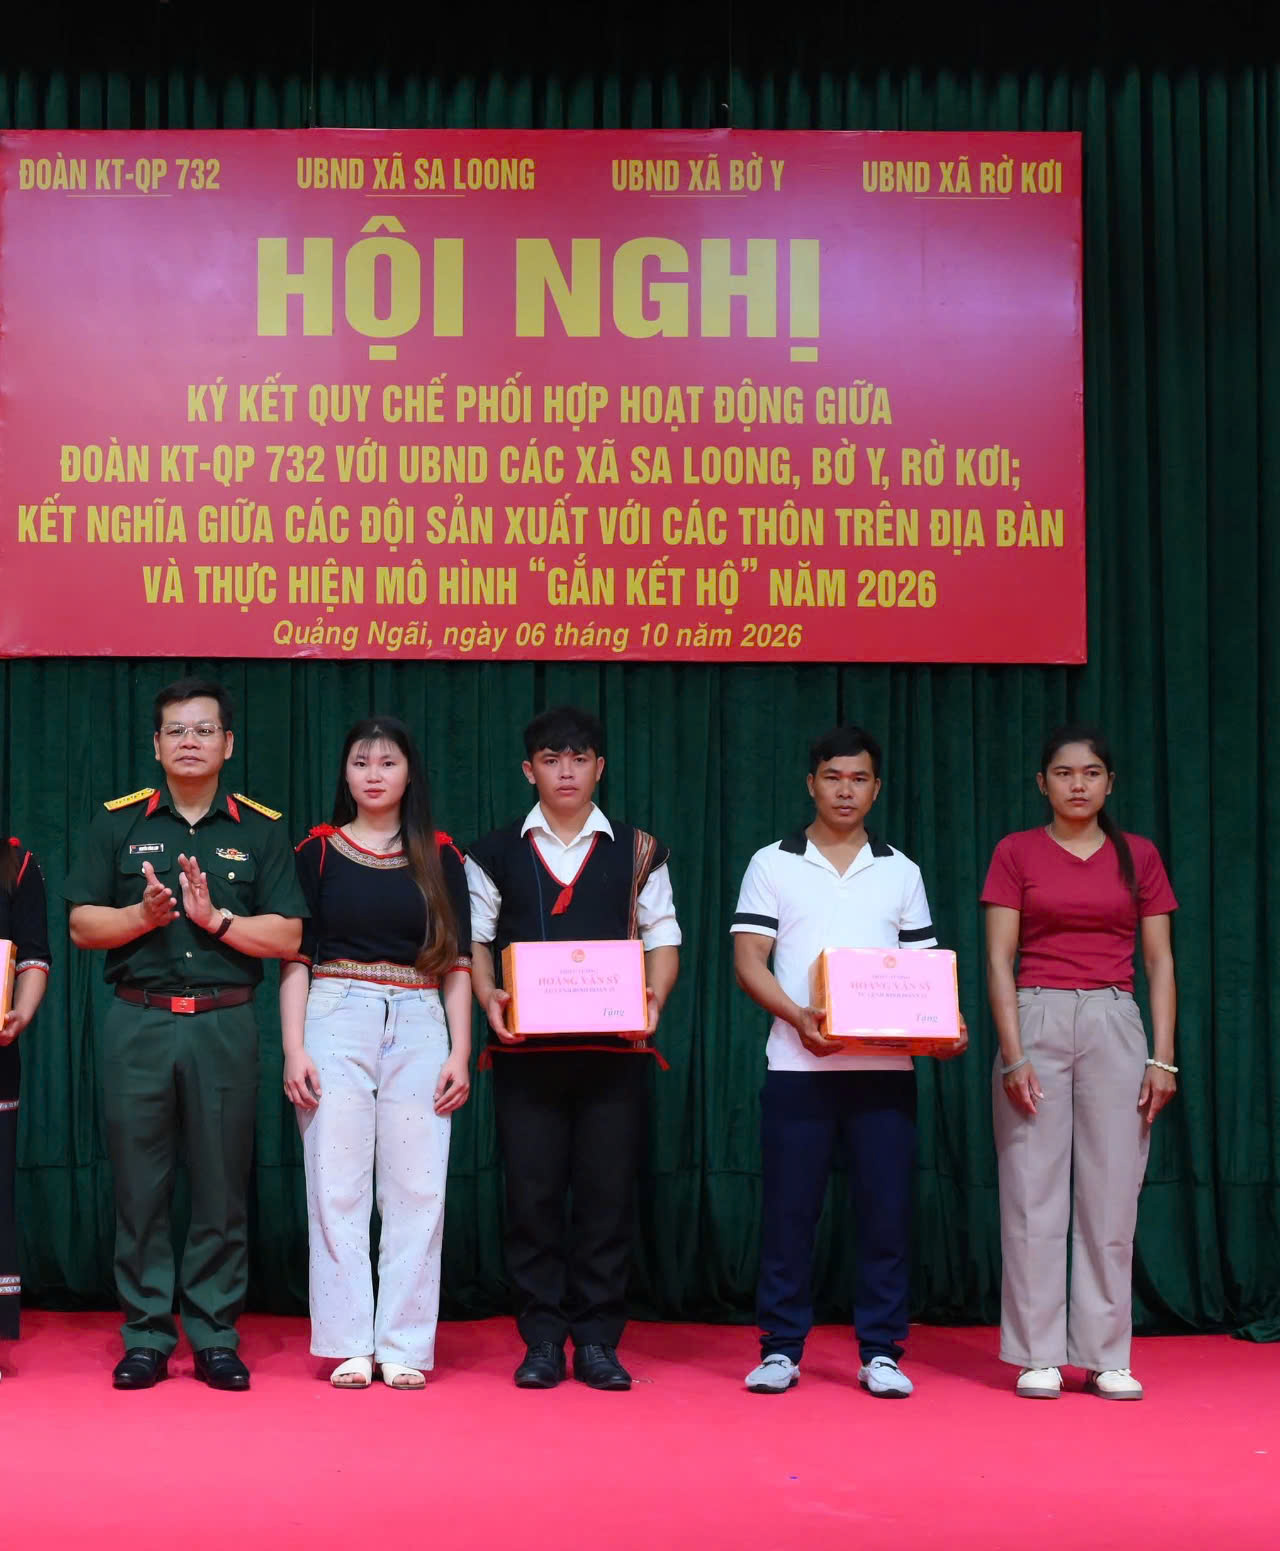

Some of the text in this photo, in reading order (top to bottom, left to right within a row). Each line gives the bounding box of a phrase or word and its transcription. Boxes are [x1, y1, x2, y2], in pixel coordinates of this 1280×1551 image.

[19, 152, 221, 193] ĐOÀN KT-QP 732
[296, 152, 535, 190] UBND XÃ SA LOONG
[612, 152, 785, 192] UBND XÃ BỜ Y
[863, 154, 1062, 194] UBND XÃ RỜ KƠI
[256, 215, 820, 363] HỘI NGHỊ
[187, 371, 893, 433] KÝ KẾT QUY CHẾ PHỐI HỢP HOẠT ĐỘNG GIỮA
[59, 436, 1020, 491] ĐOÀN KT-QP 732 VỚI UBND CÁC XÃ SA LOONG, BỜ Y, RỜ KƠI;
[17, 492, 1064, 556] KẾT NGHĨA GIỮA CÁC ĐỘI SẢN XUẤT VỚI CÁC THÔN TRÊN ĐỊA BÀN
[142, 557, 185, 604] VÀ
[193, 561, 278, 613] THỰC
[288, 557, 365, 613] HIỆN
[375, 558, 428, 605] MÔ
[438, 558, 517, 605] HÌNH
[626, 555, 686, 606] KẾT
[769, 560, 846, 607] NĂM
[857, 569, 937, 608] 2026
[273, 616, 803, 653] Quảng Ngãi, ngày 06 tháng 10 năm 2026
